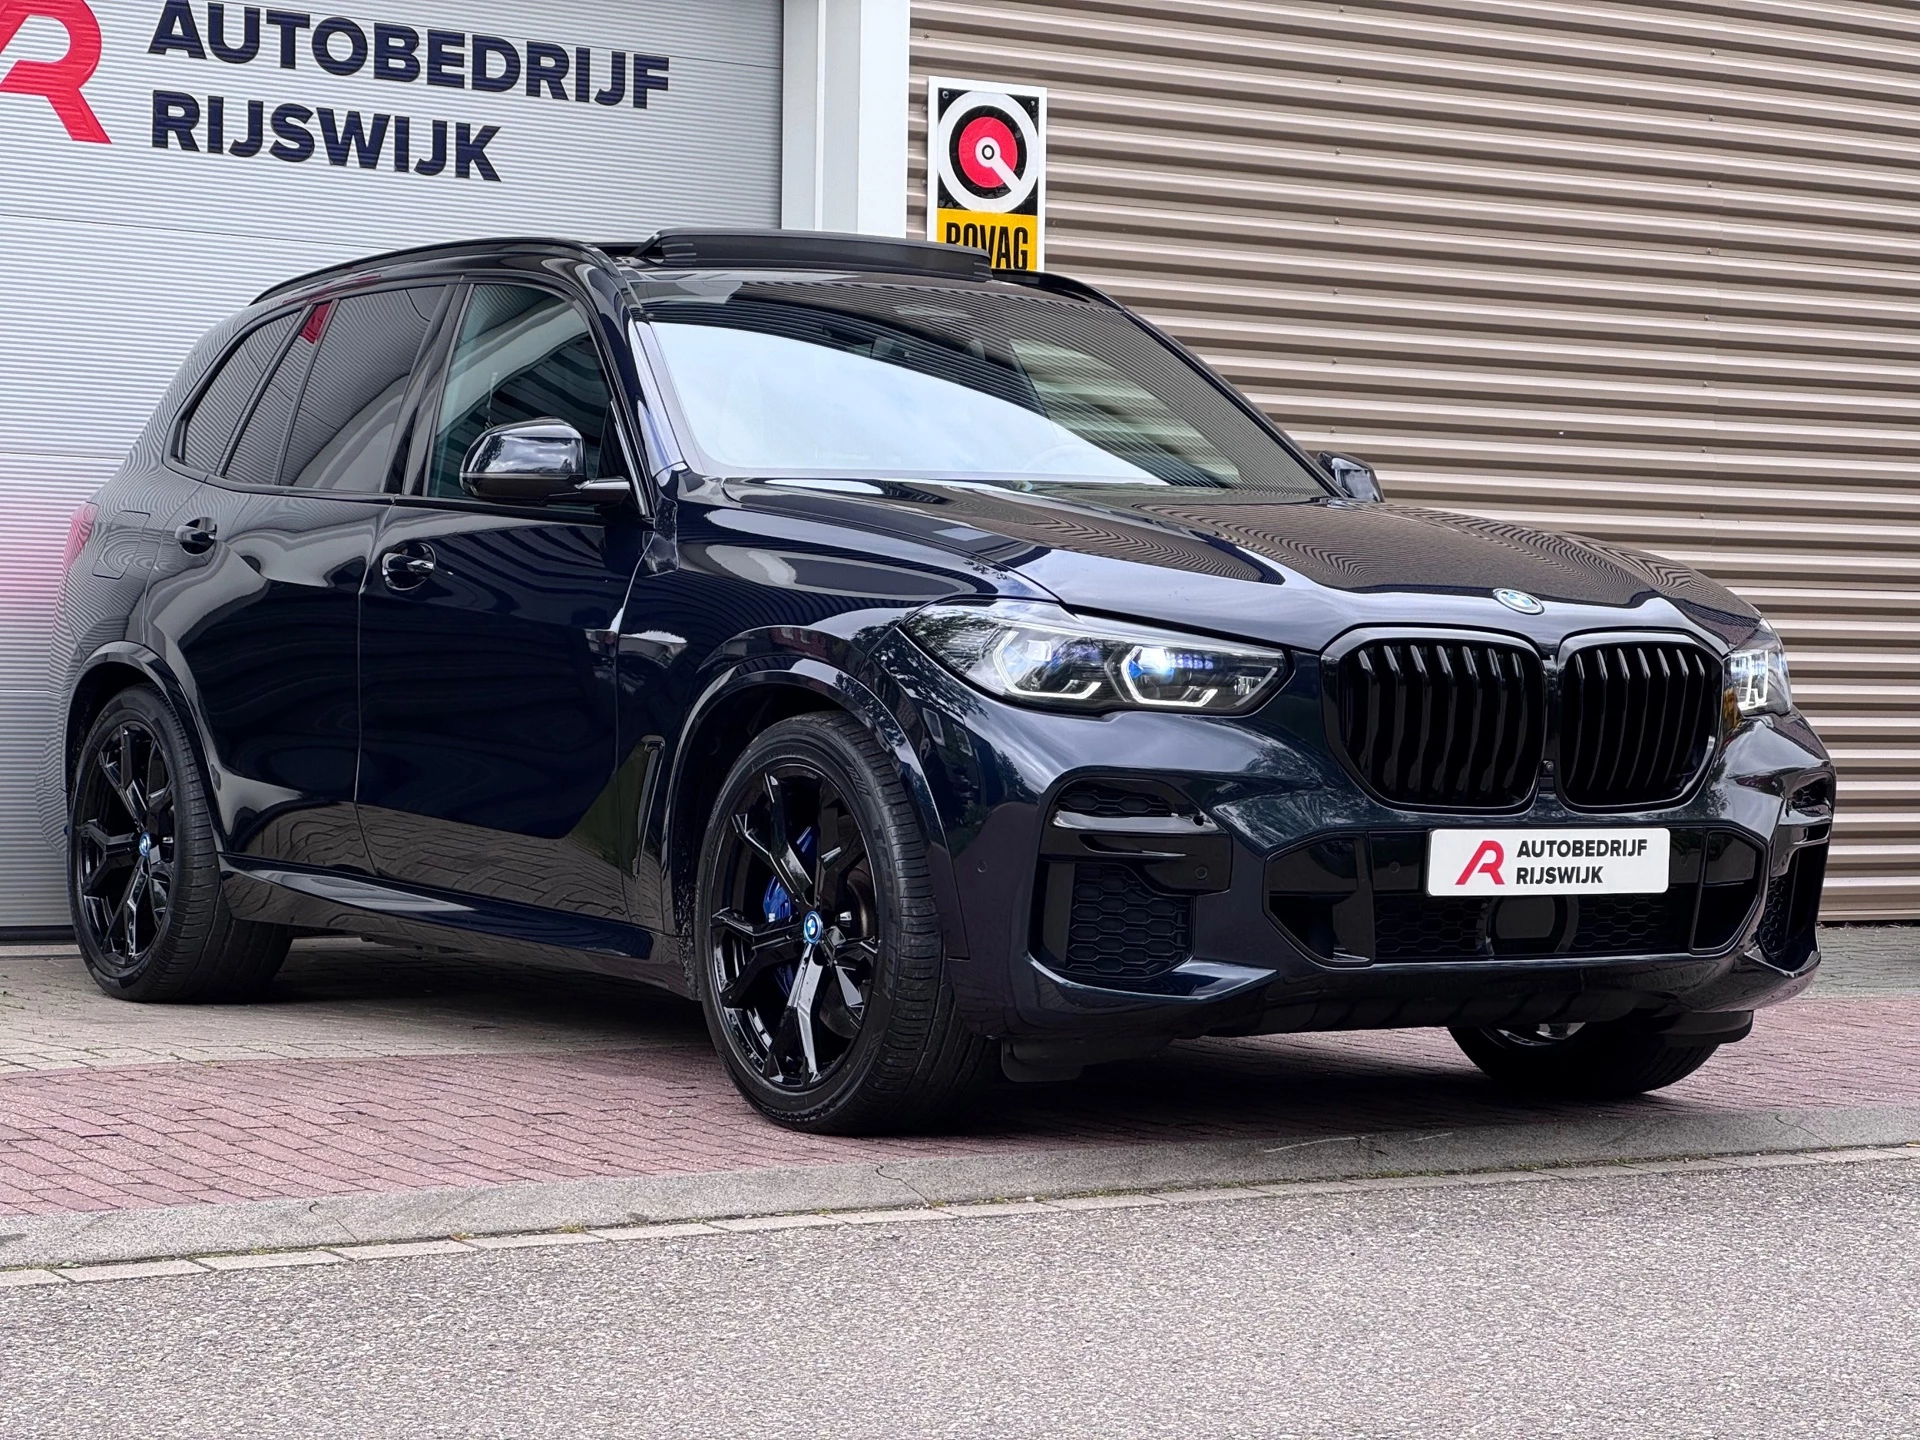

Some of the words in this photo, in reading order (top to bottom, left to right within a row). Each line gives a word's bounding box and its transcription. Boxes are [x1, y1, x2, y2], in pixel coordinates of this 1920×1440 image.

[147, 0, 670, 110] AUTOBEDRIJF
[152, 89, 502, 182] RIJSWIJK
[1516, 839, 1647, 857] AUTOBEDRIJF
[1516, 866, 1603, 884] RIJSWIJK
